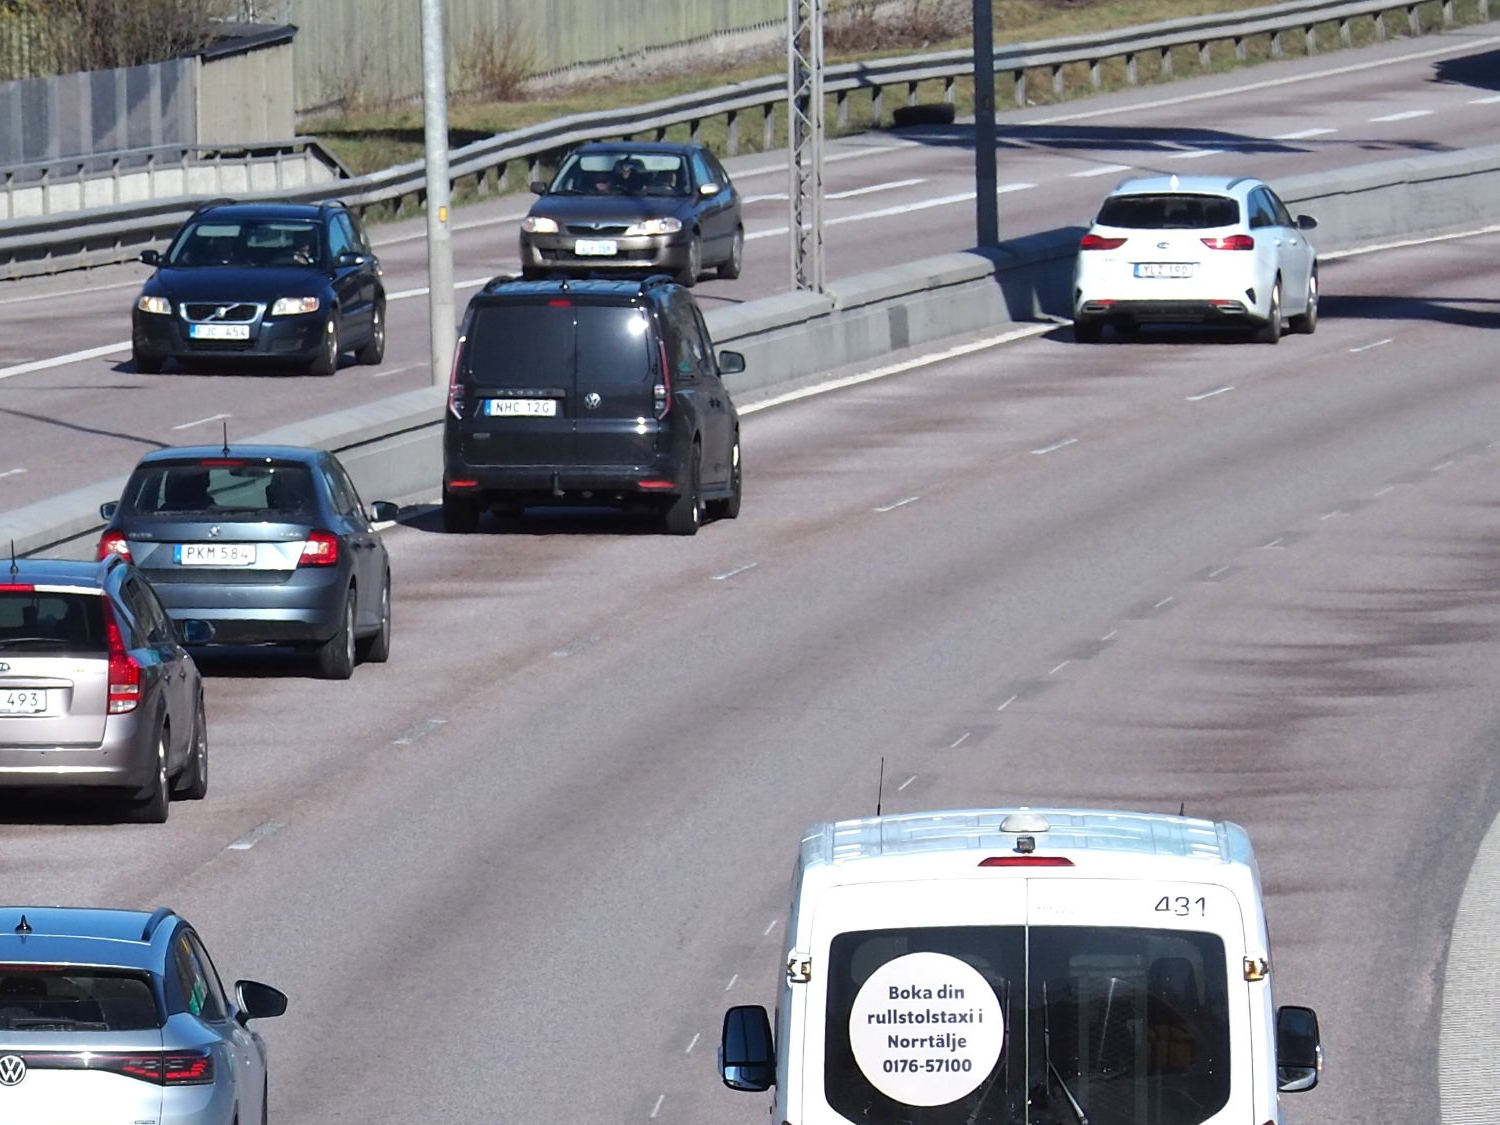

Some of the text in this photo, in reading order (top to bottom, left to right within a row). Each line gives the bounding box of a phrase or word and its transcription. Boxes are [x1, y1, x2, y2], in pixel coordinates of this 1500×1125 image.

[496, 401, 550, 414] NHC 12G
[187, 546, 216, 559] PKM
[7, 692, 39, 707] 493
[1154, 896, 1206, 917] 431
[888, 984, 965, 999] Boka din
[867, 1008, 974, 1025] rullstolstaxi
[887, 1032, 967, 1052] Norrtälje
[882, 1058, 972, 1073] 0176-57100
